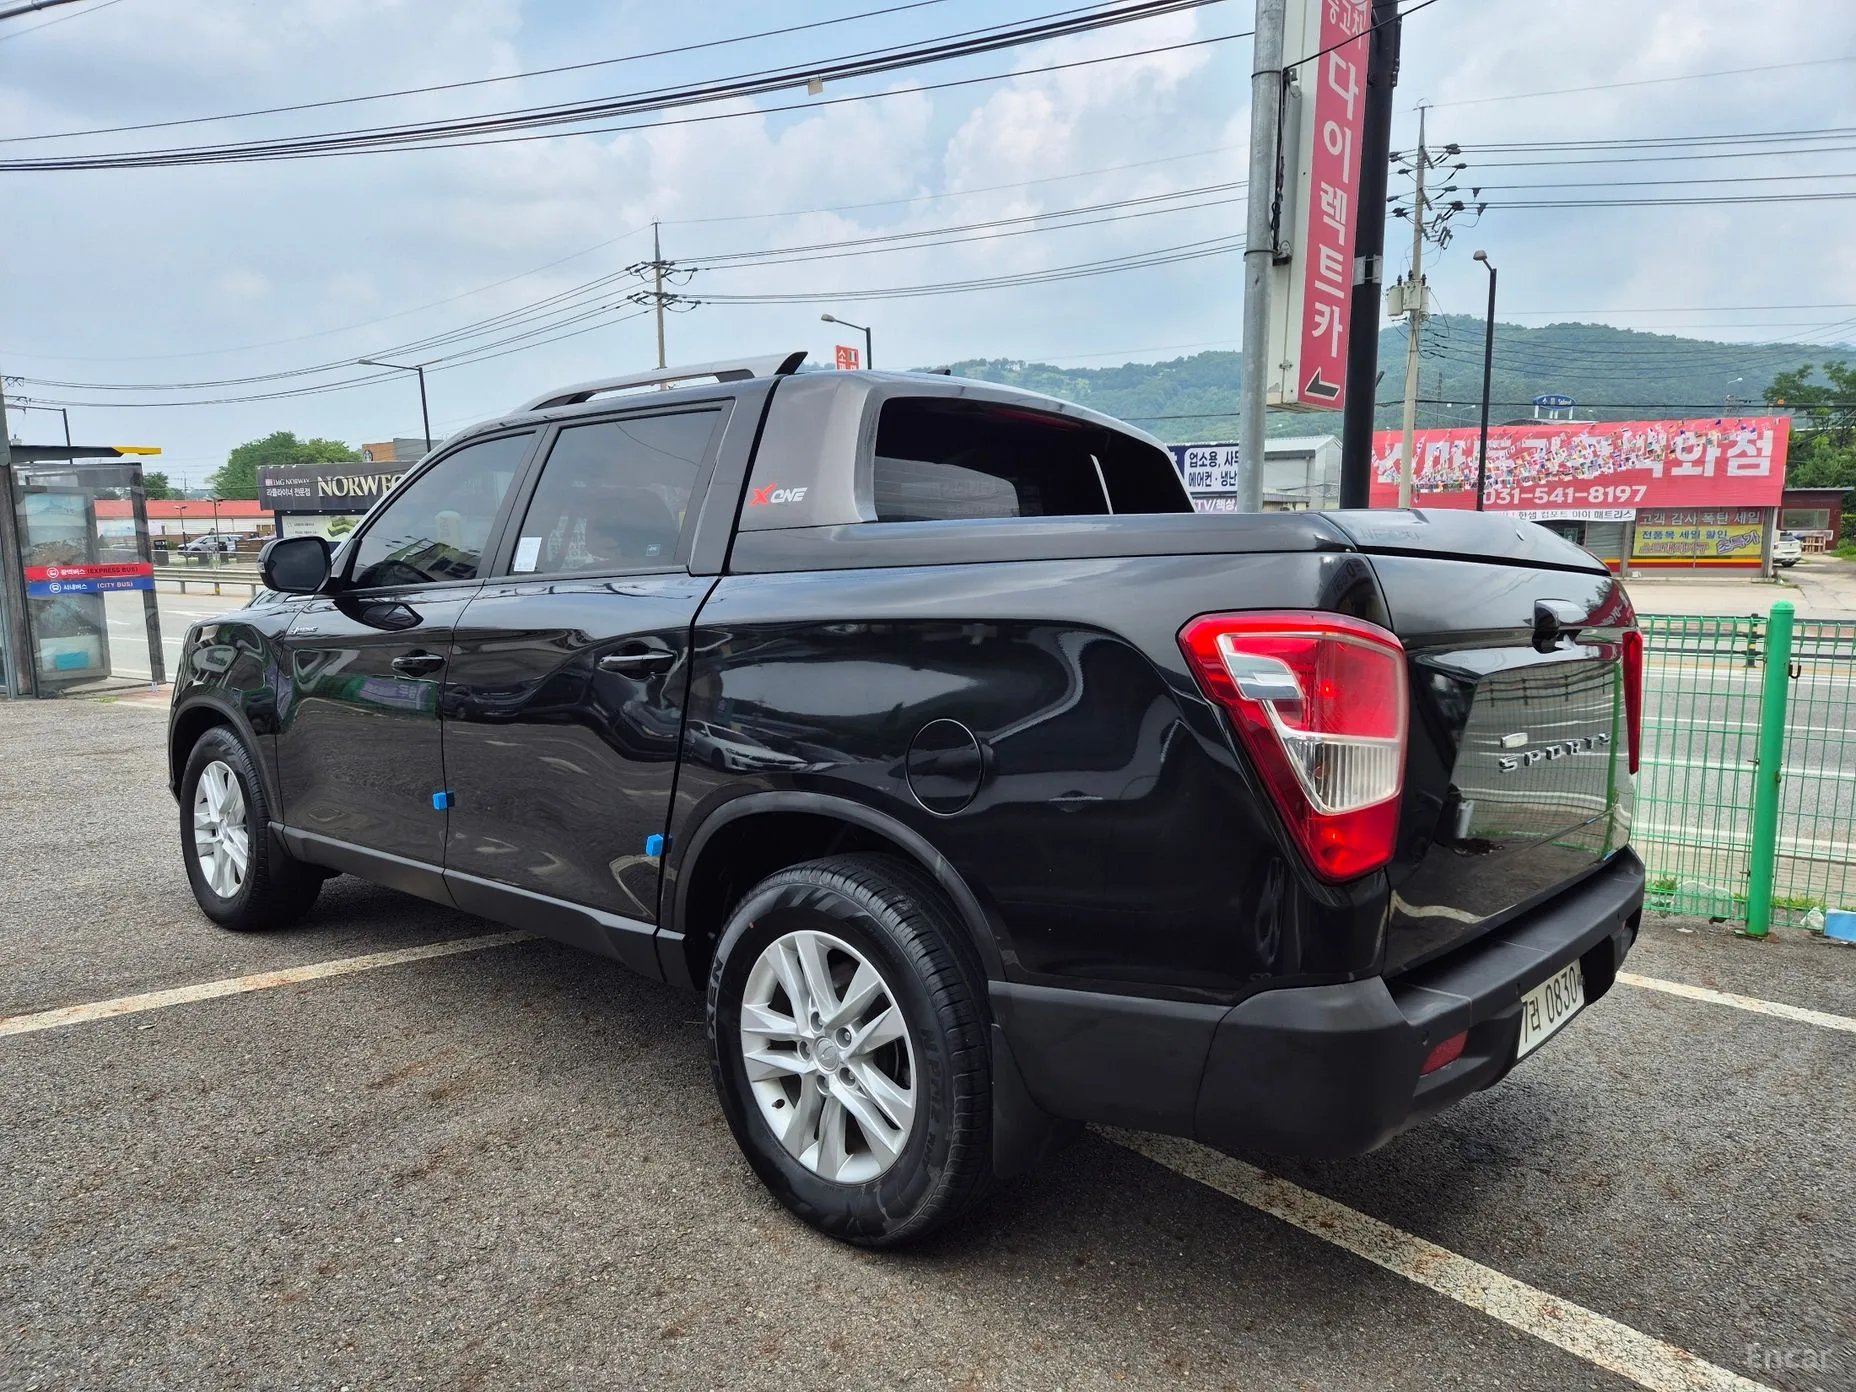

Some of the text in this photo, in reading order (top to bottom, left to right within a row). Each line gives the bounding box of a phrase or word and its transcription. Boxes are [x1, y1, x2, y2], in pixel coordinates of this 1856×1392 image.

[1312, 51, 1359, 358] 다이렉트카
[1189, 451, 1221, 468] 업소용,
[1188, 471, 1213, 487] 에어컨
[1483, 485, 1648, 504] 031-541-8197
[1594, 510, 1633, 519] 매트리스
[1640, 511, 1760, 525] 고객 감사 폭탄 세일
[1642, 530, 1675, 539] 전품목
[1679, 530, 1700, 539] 세일
[63, 583, 88, 591] 시내버스
[1499, 732, 1610, 773] SPORTS
[1545, 966, 1578, 1024] 0830
